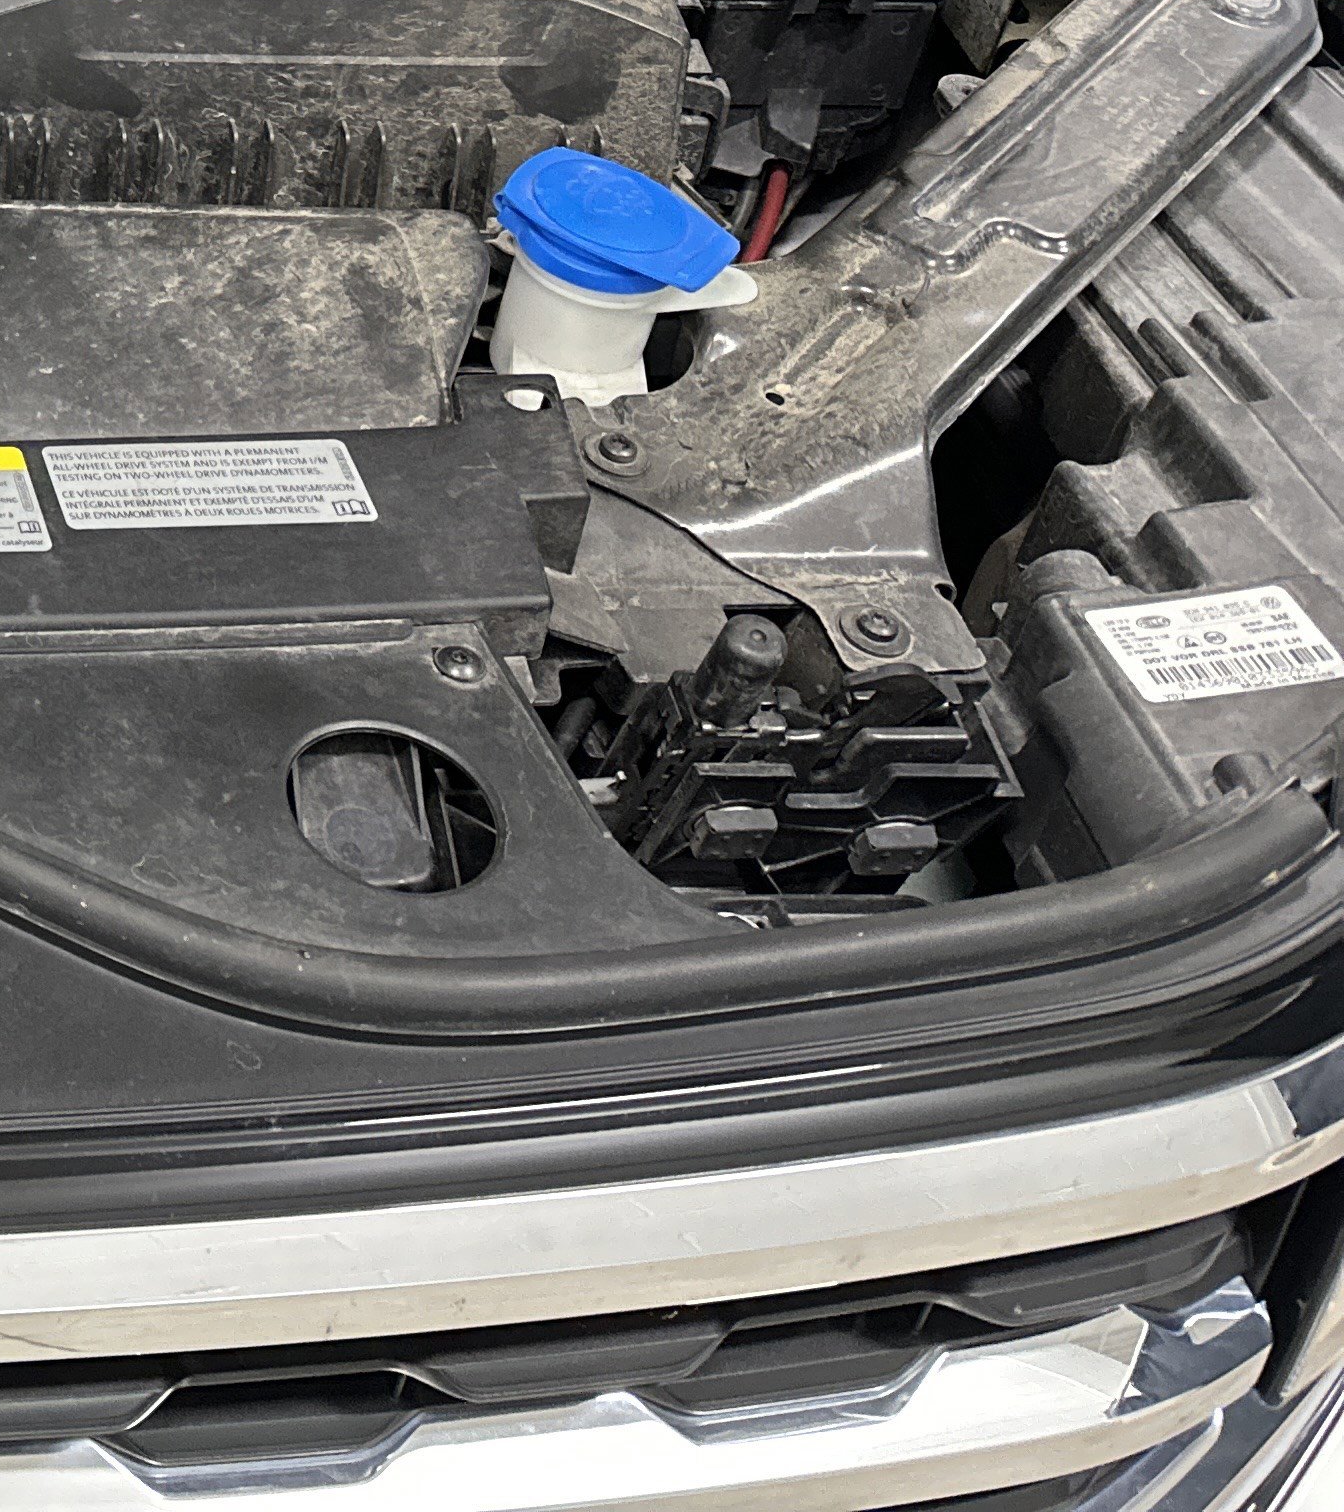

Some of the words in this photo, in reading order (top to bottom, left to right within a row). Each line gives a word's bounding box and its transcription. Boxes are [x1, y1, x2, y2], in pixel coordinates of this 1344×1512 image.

[48, 452, 74, 461] THIS
[74, 451, 121, 460] VEHICLE
[123, 451, 132, 459] IS
[135, 449, 189, 459] EQUIPPED
[234, 447, 300, 456] PERMANENT
[52, 462, 115, 471] ALL-WHEEL
[115, 461, 146, 470] DRIVE
[150, 460, 190, 469] SYSTEM
[220, 459, 230, 467] IS
[233, 458, 273, 466] EXEMPT
[276, 457, 307, 465] FROM
[310, 457, 328, 465] I/M
[55, 473, 102, 482] TESTING
[104, 472, 121, 480] ON
[123, 471, 194, 480] TWO-WHEEL
[195, 470, 228, 478] DRIVE
[230, 467, 323, 477] DYNAMOMETERS.
[62, 490, 77, 499] CE
[76, 488, 129, 498] VÉHICULE
[132, 488, 148, 497] EST
[183, 487, 211, 495] D'UN
[259, 485, 275, 493] DE
[275, 483, 356, 493] TRANSMISSION
[65, 500, 122, 509] INTÉGRALE
[124, 498, 187, 508] PERMANENT
[189, 498, 201, 507] ET
[69, 512, 91, 520] SUR
[194, 508, 224, 517] DEUX
[226, 507, 263, 516] ROUES
[265, 506, 320, 514] MOTRICES.
[1271, 612, 1290, 621] SAE
[1171, 653, 1198, 661] VOR
